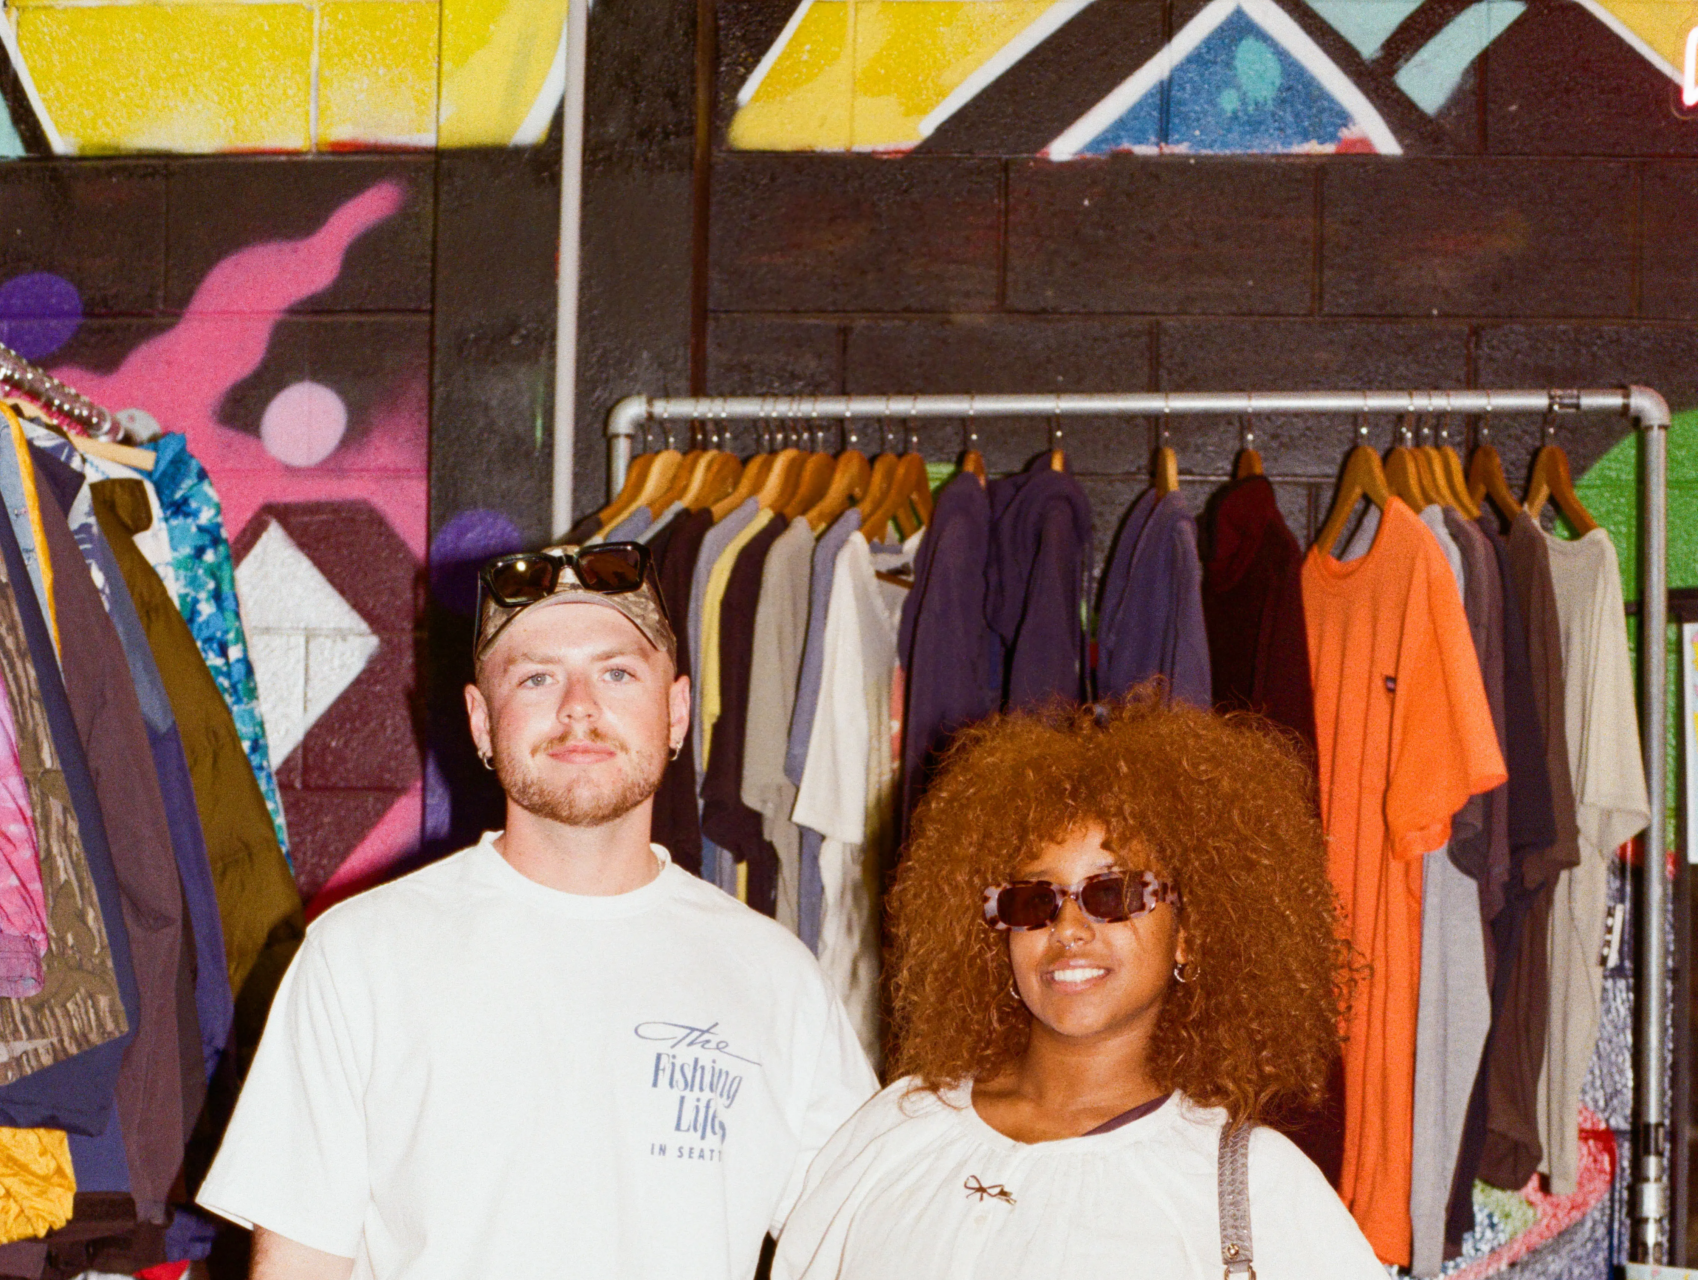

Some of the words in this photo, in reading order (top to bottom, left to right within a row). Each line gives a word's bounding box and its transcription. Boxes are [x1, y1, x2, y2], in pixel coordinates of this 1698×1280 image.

[634, 1021, 762, 1066] The
[651, 1052, 743, 1109] Fishing
[650, 1143, 667, 1157] IN
